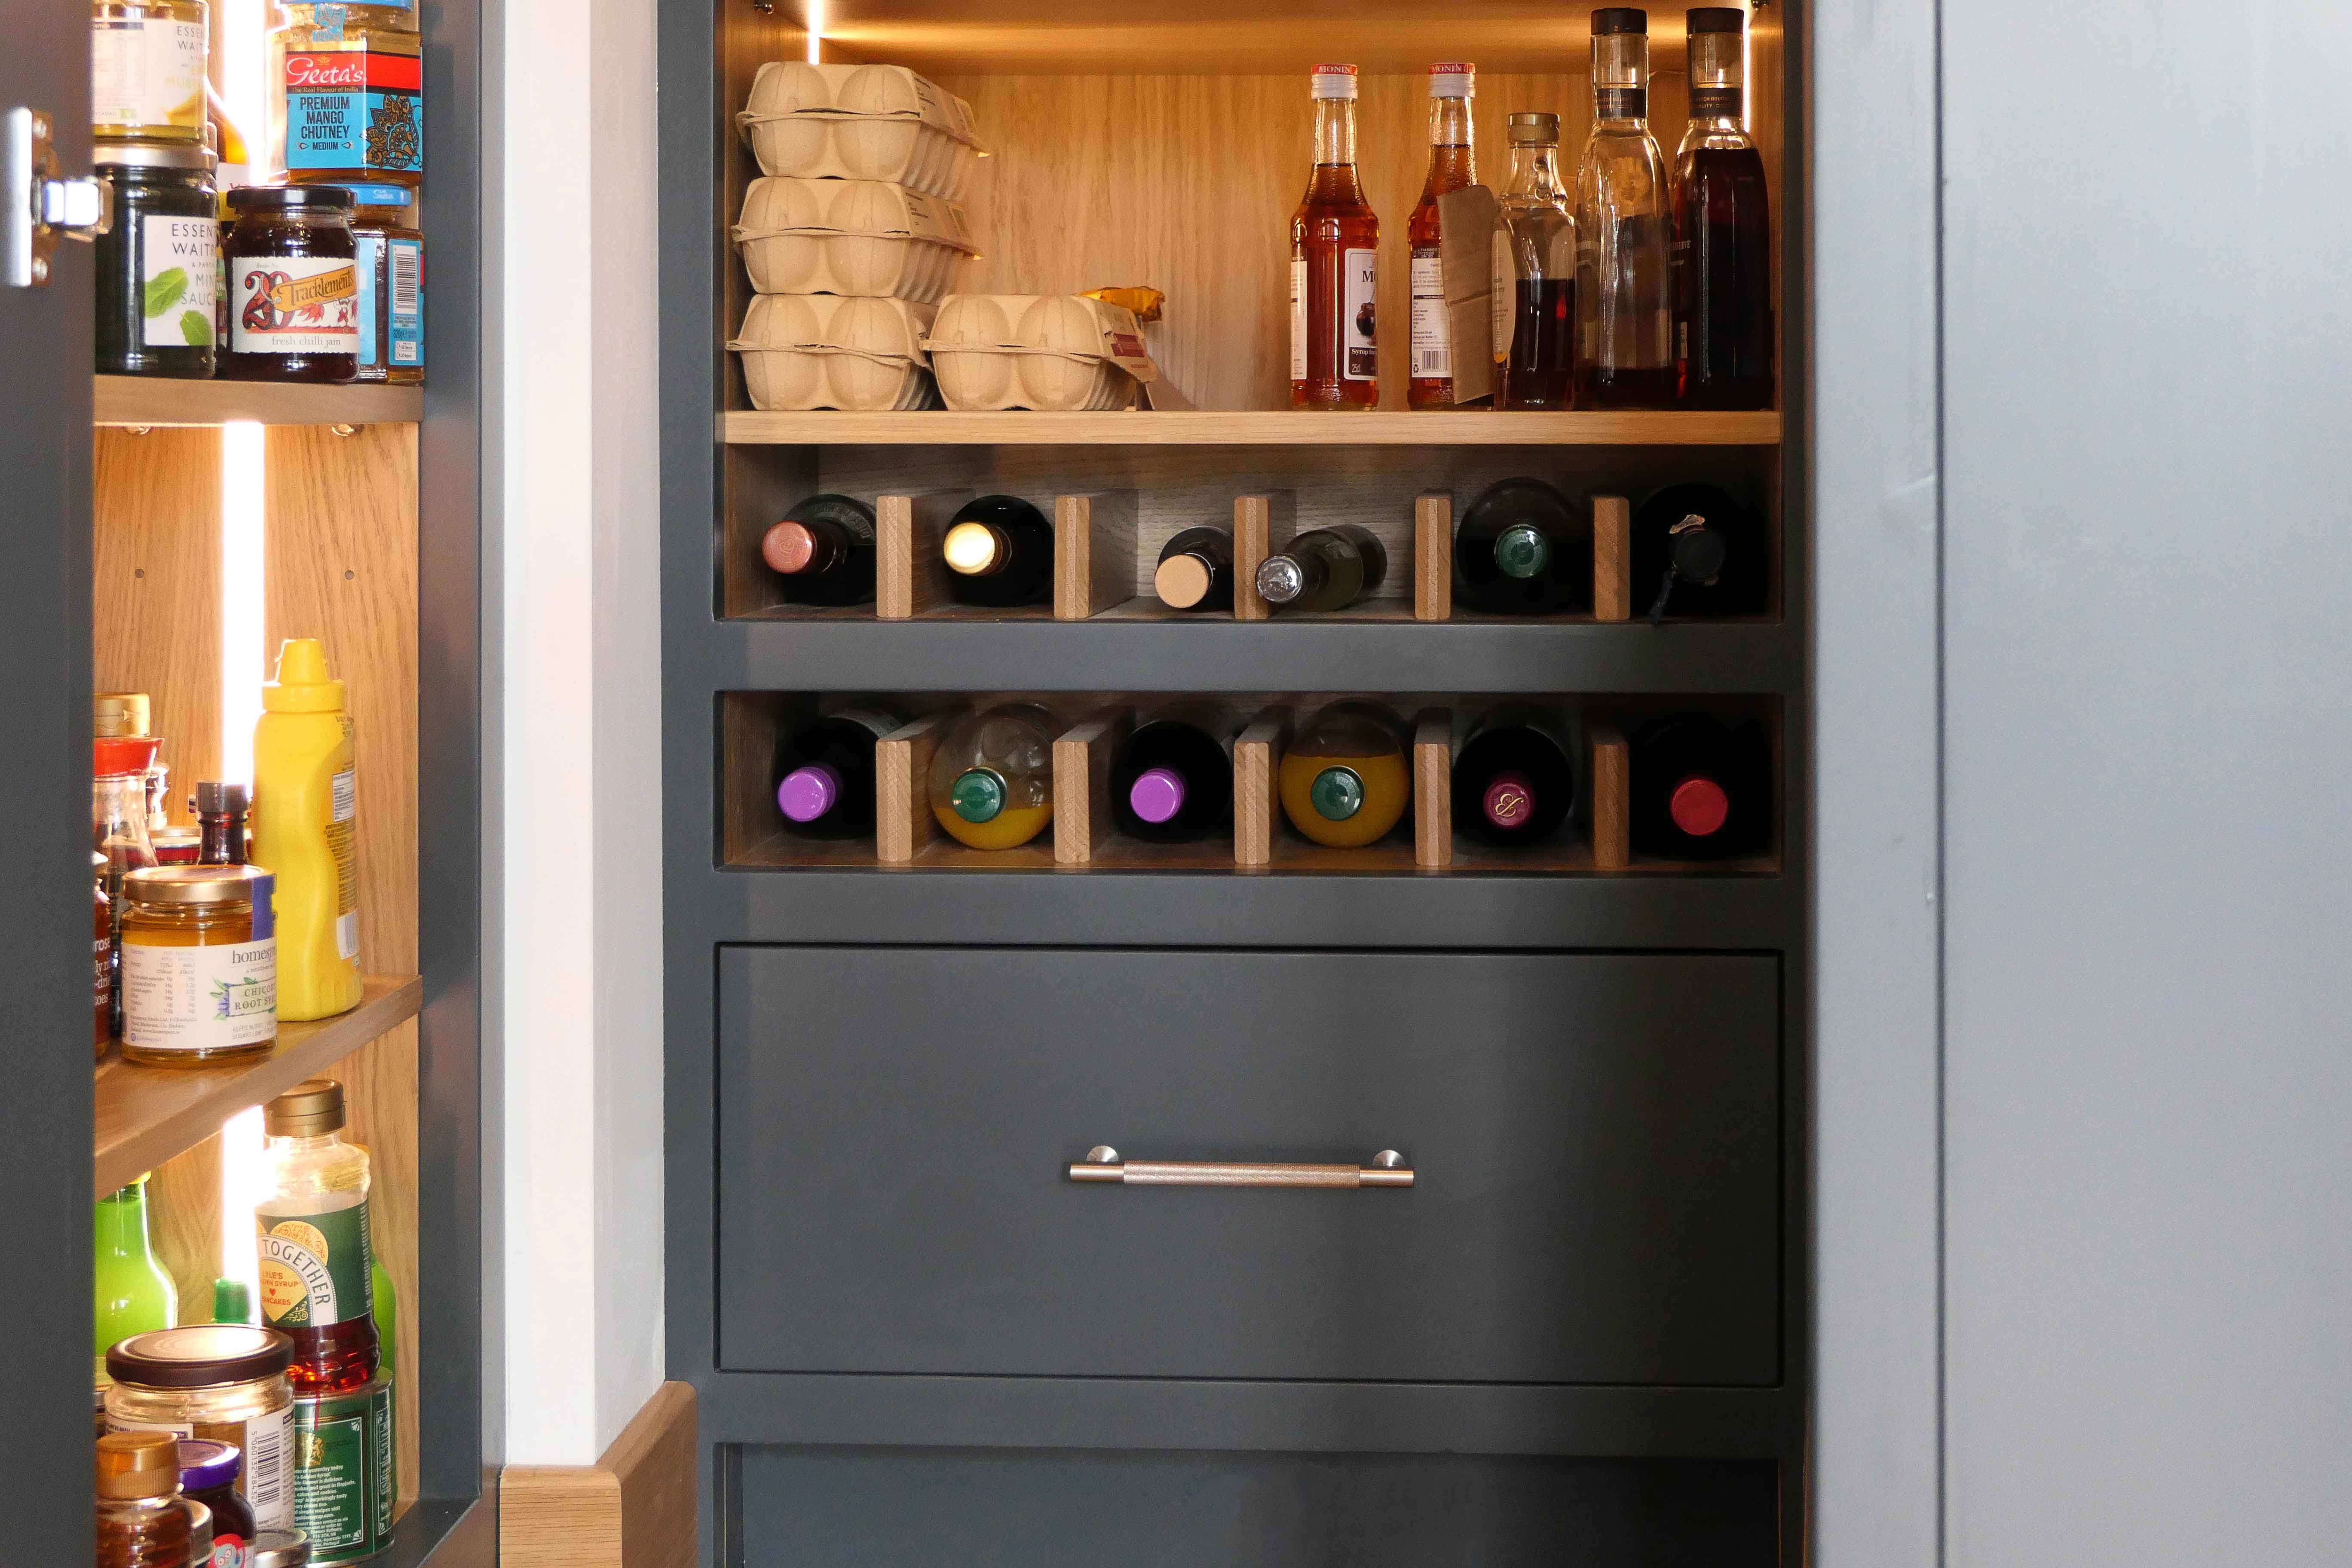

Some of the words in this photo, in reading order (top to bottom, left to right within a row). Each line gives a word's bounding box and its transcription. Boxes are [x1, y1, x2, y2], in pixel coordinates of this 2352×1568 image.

[287, 57, 364, 86] Geeta's
[300, 96, 350, 110] PREMIUM
[306, 111, 344, 124] MANGO
[301, 125, 350, 139] CHUTNEY
[312, 142, 339, 150] MEDIUM
[277, 268, 354, 306] Tracklements
[272, 336, 296, 345] fresh
[299, 336, 323, 345] chilli
[325, 337, 341, 348] jam
[234, 998, 261, 1010] ROOT
[262, 1239, 331, 1305] TOGETHER
